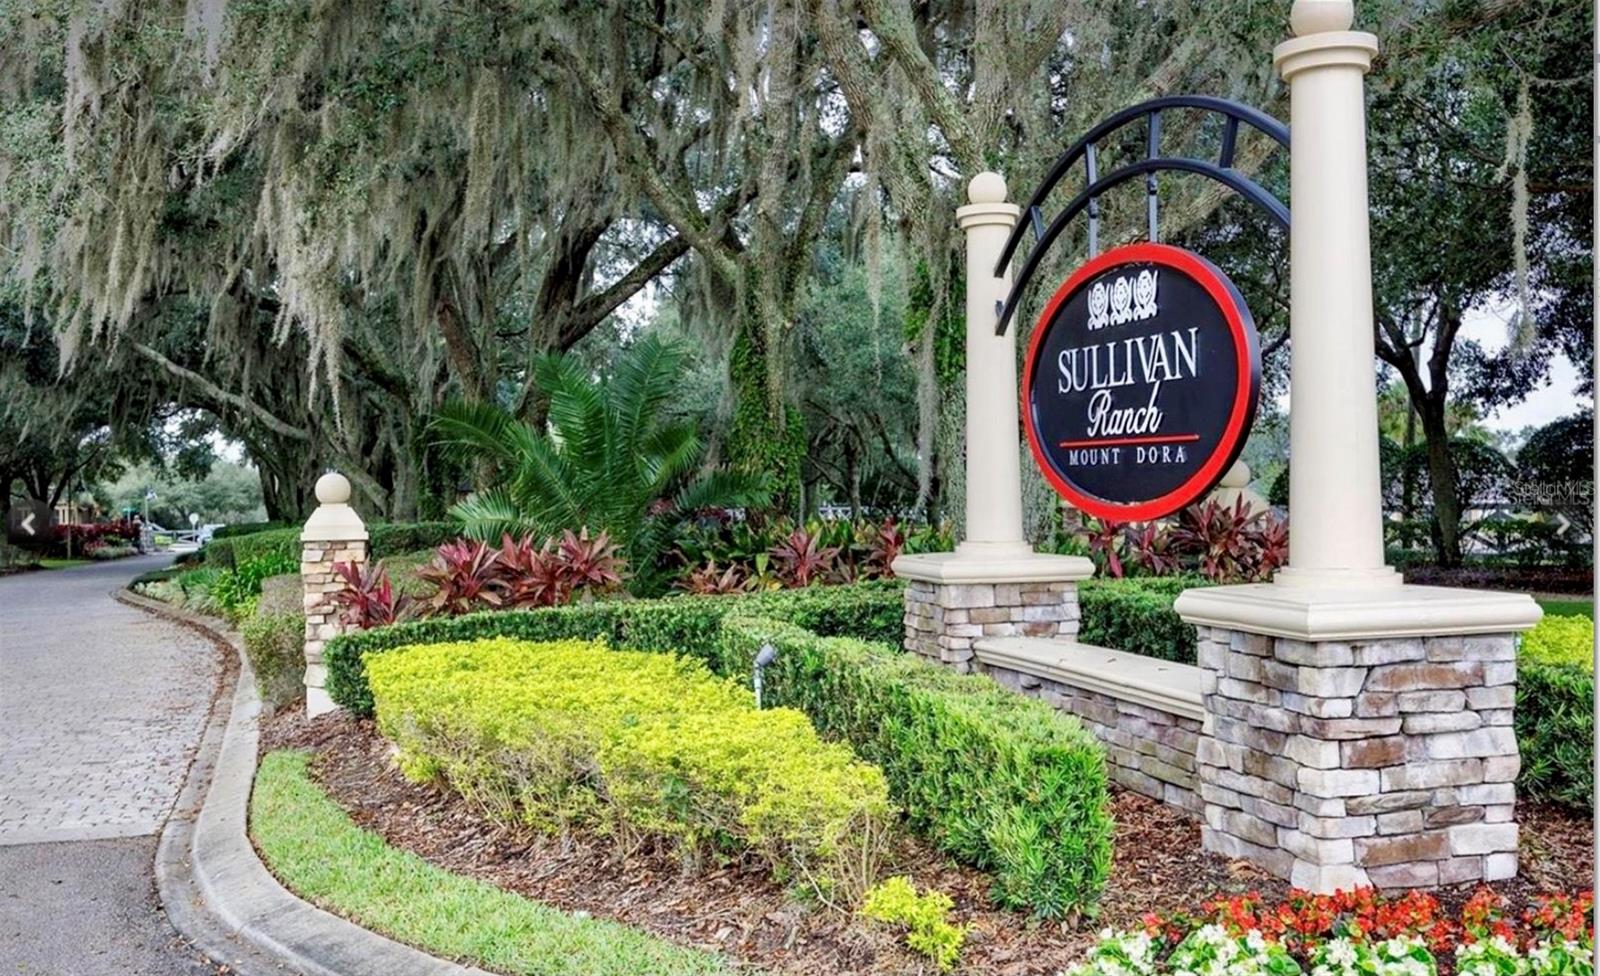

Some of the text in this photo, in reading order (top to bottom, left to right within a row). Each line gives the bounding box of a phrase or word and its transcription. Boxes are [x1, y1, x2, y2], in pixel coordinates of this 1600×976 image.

[1058, 327, 1199, 394] SULLIVAN
[1087, 381, 1162, 437] Ranch
[1069, 446, 1186, 466] MOUNT DORA
